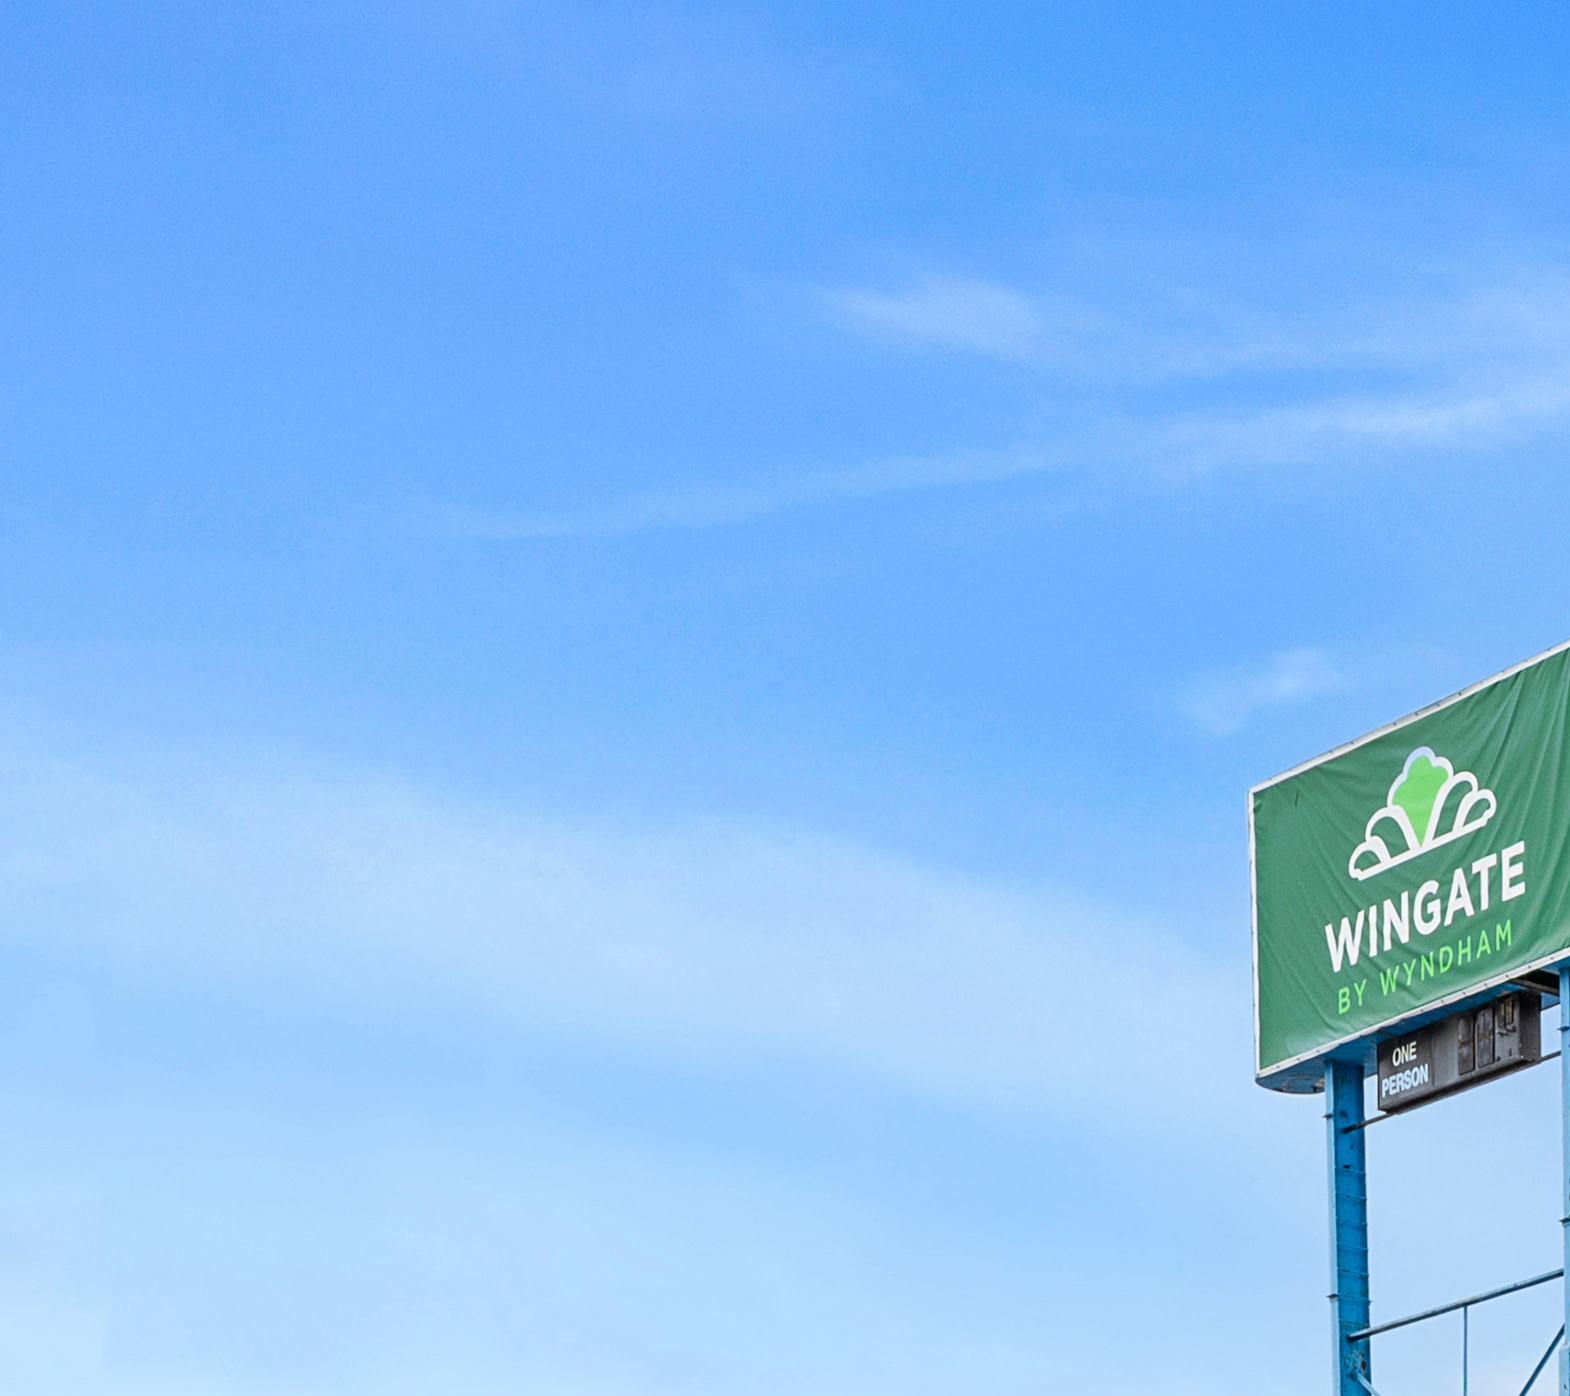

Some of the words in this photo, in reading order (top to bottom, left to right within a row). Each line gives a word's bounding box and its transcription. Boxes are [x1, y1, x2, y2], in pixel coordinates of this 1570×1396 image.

[1324, 840, 1526, 974] WINGATE
[1338, 979, 1367, 1015] BY
[1379, 919, 1512, 997] WYNDHAM
[1381, 1063, 1429, 1099] PERSON
[1392, 1040, 1418, 1067] ONE
